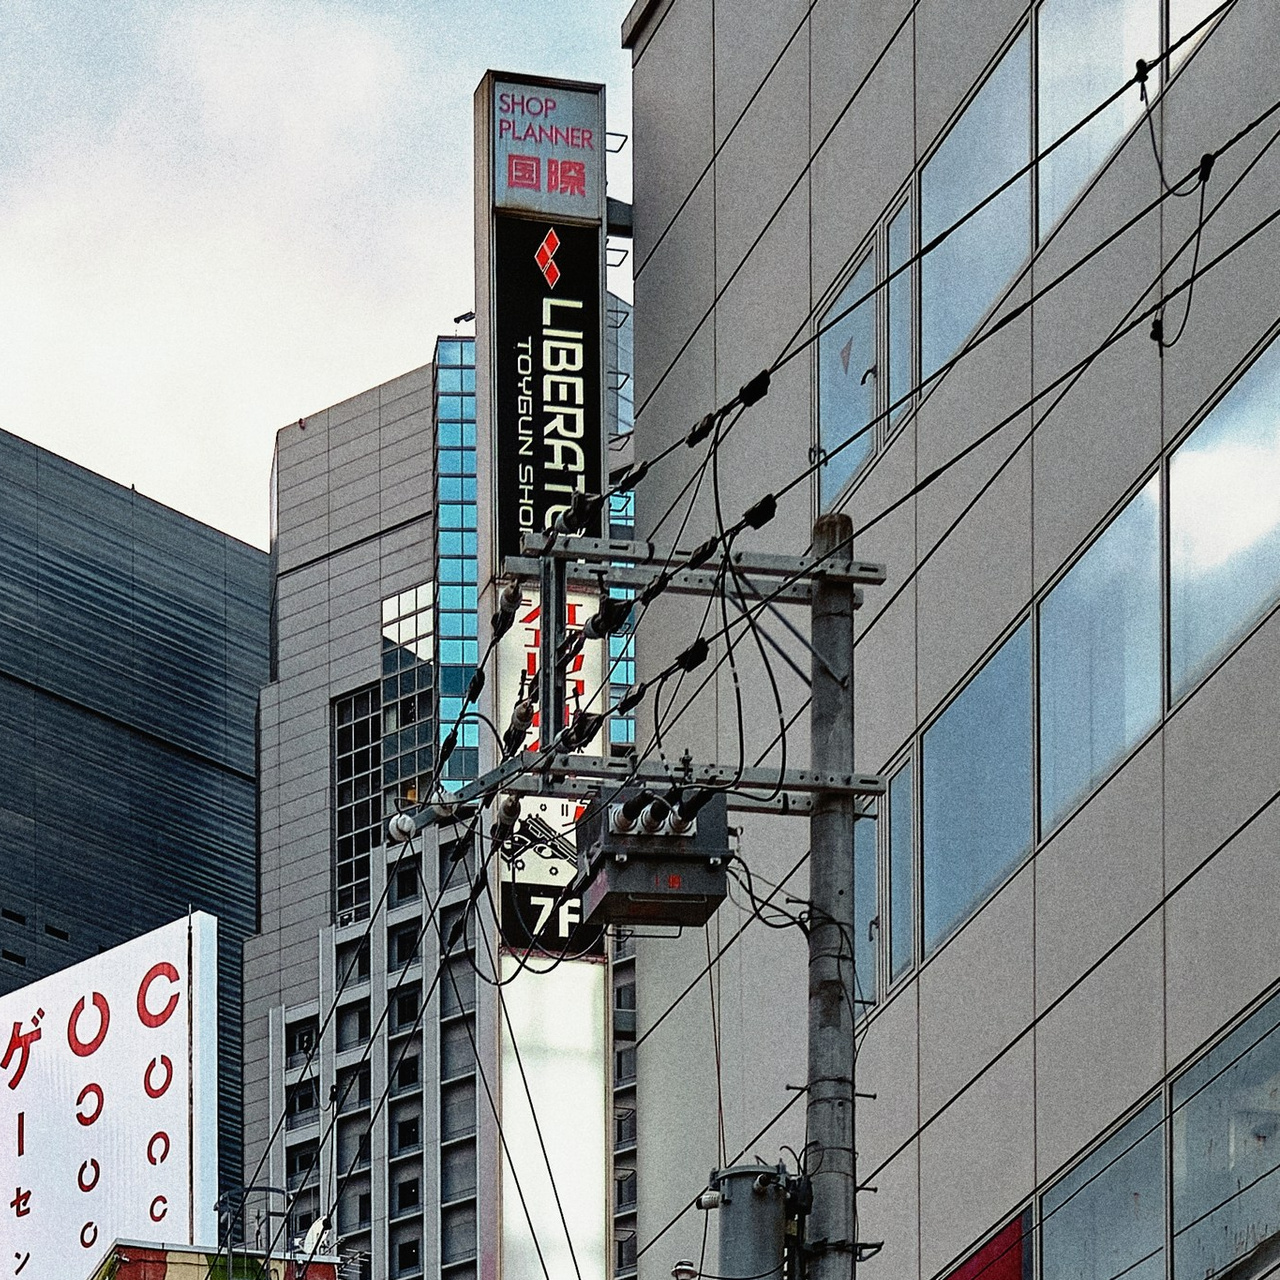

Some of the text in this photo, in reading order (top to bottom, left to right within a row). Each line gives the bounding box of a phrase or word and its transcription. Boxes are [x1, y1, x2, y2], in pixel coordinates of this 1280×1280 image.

[498, 93, 557, 119] SHOP
[498, 119, 594, 149] PLANNER
[507, 154, 586, 197] 国際
[517, 335, 533, 460] TOYGUN
[542, 297, 586, 563] LIBERATO
[529, 896, 582, 938] 7F
[0, 1007, 46, 1276] ゲーセン
